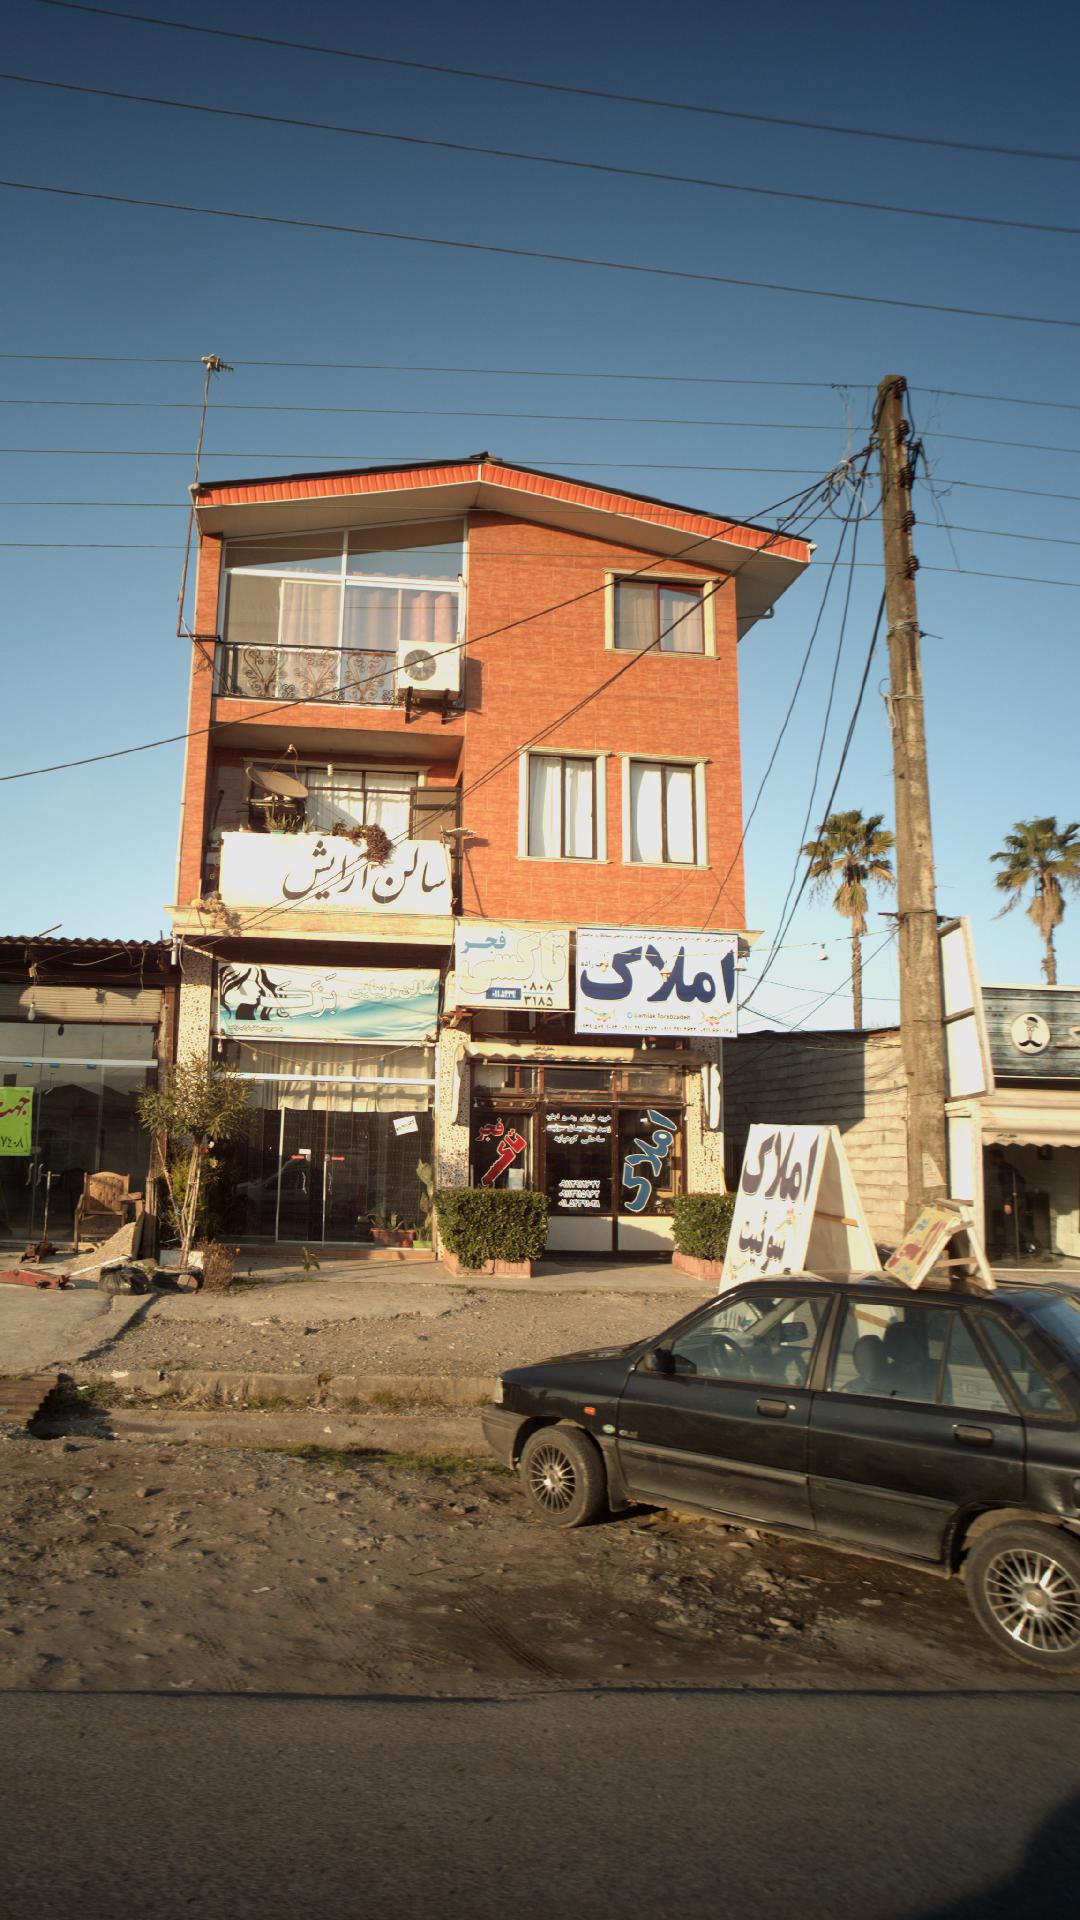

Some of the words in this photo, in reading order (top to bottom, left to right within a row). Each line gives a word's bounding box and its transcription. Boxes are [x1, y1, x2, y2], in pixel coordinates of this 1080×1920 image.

[372, 848, 446, 903] سالن
[460, 931, 507, 954] فجر
[580, 944, 736, 1003] املاک
[475, 1117, 504, 1141] فجر
[741, 1130, 820, 1202] املاک
